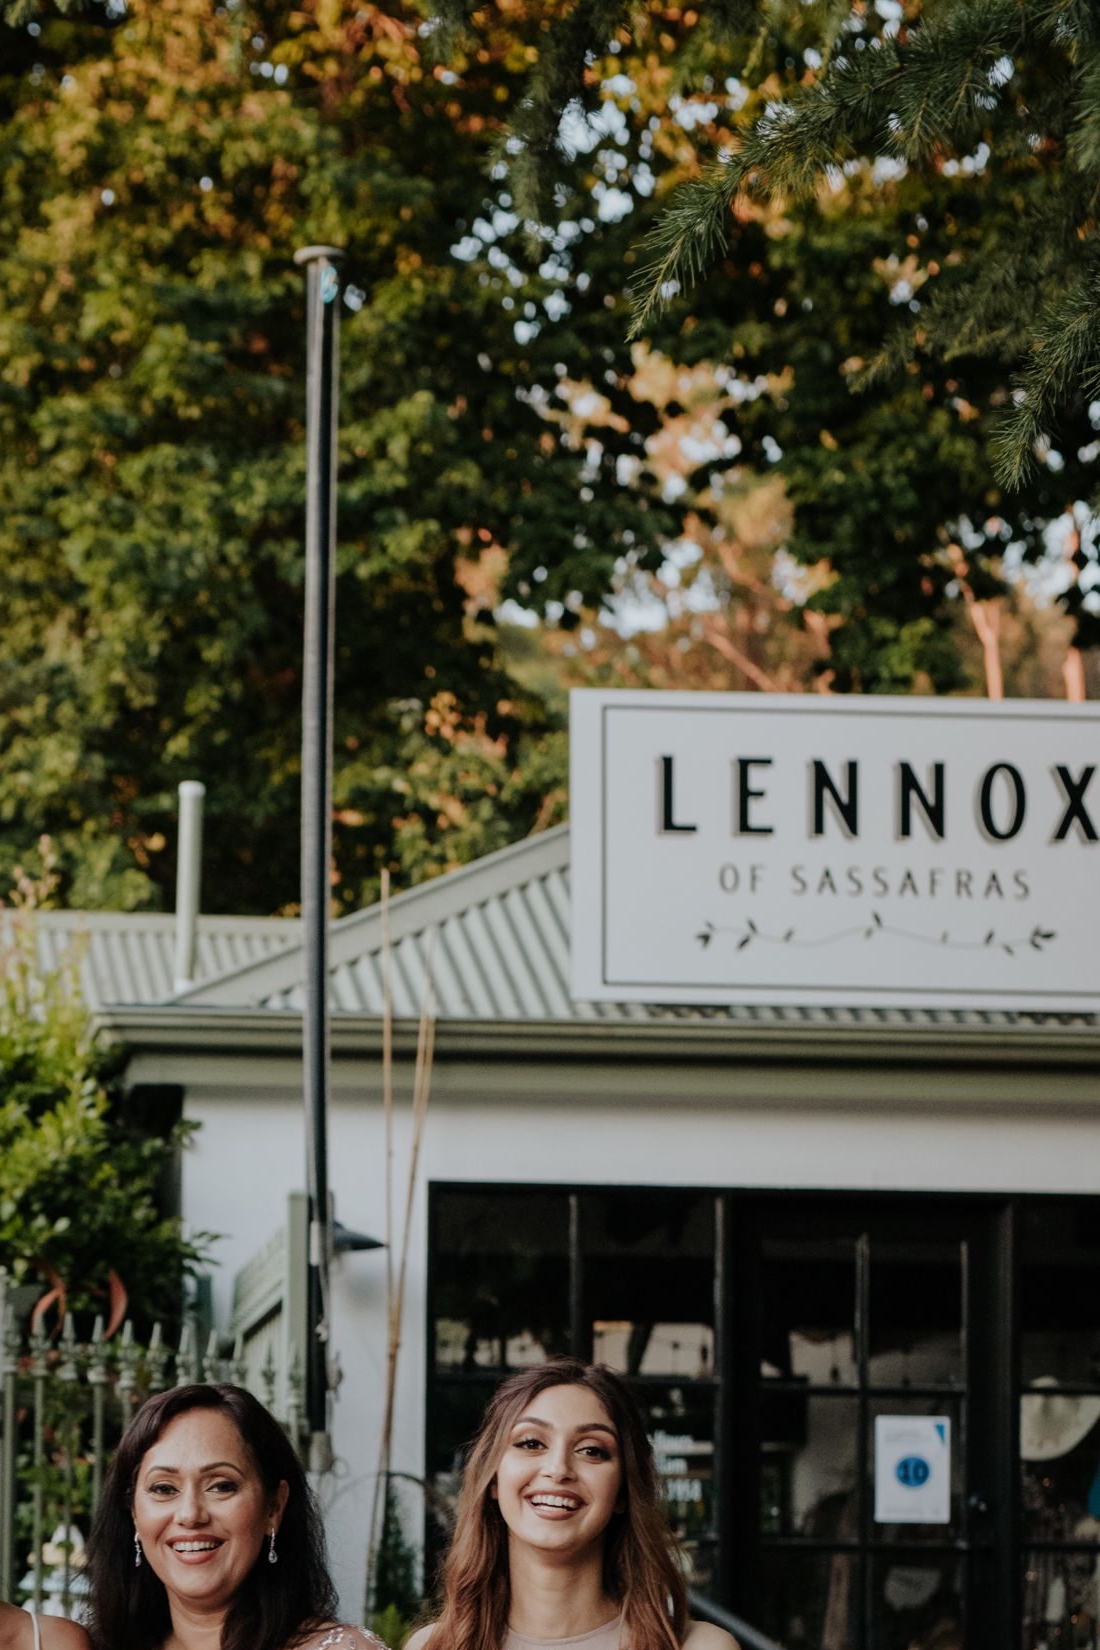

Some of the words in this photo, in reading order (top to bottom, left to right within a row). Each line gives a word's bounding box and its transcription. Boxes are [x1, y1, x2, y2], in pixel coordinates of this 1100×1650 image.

[660, 755, 1100, 842] LENNOX
[718, 862, 766, 895] OF
[790, 863, 1031, 901] SASSAFRAS
